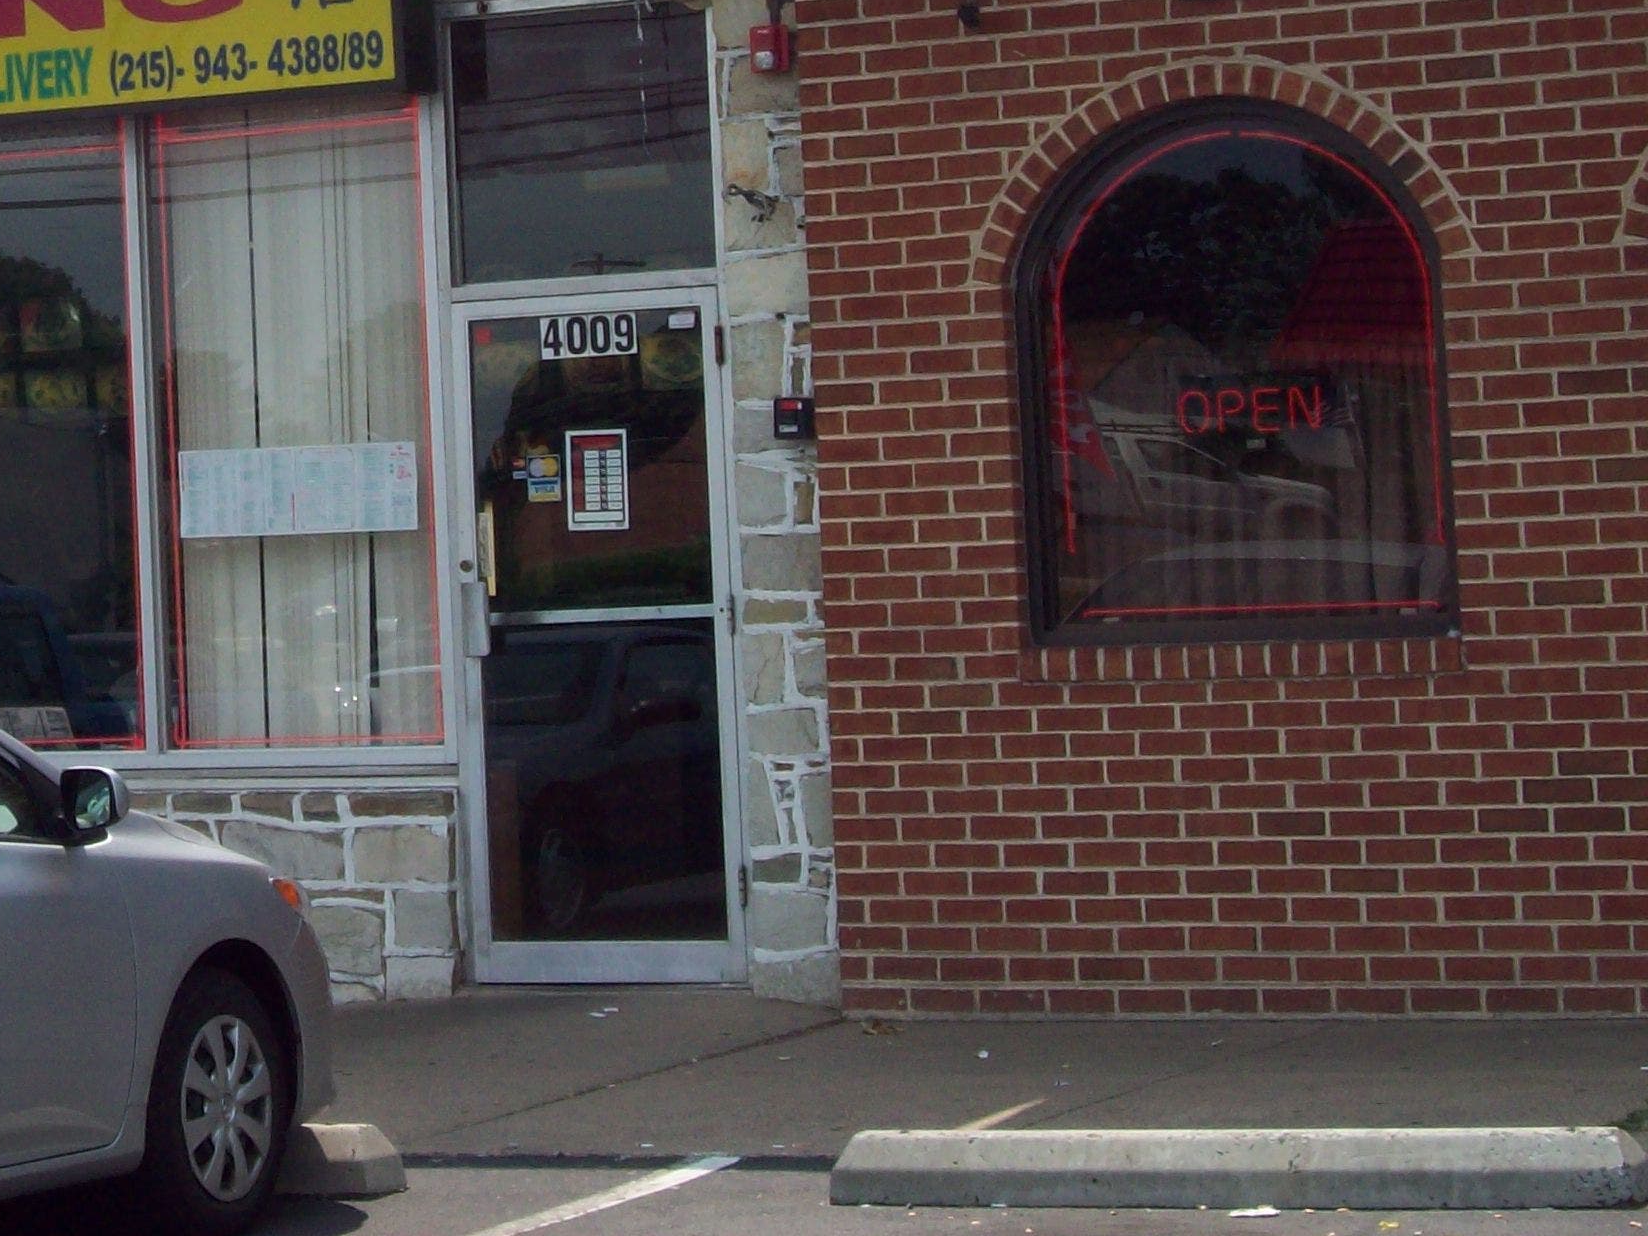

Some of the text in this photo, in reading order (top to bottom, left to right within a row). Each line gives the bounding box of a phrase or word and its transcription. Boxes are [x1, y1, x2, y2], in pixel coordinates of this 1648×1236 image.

[268, 29, 385, 77] 4388/89
[543, 315, 635, 356] 4009
[1176, 385, 1322, 434] OPEN
